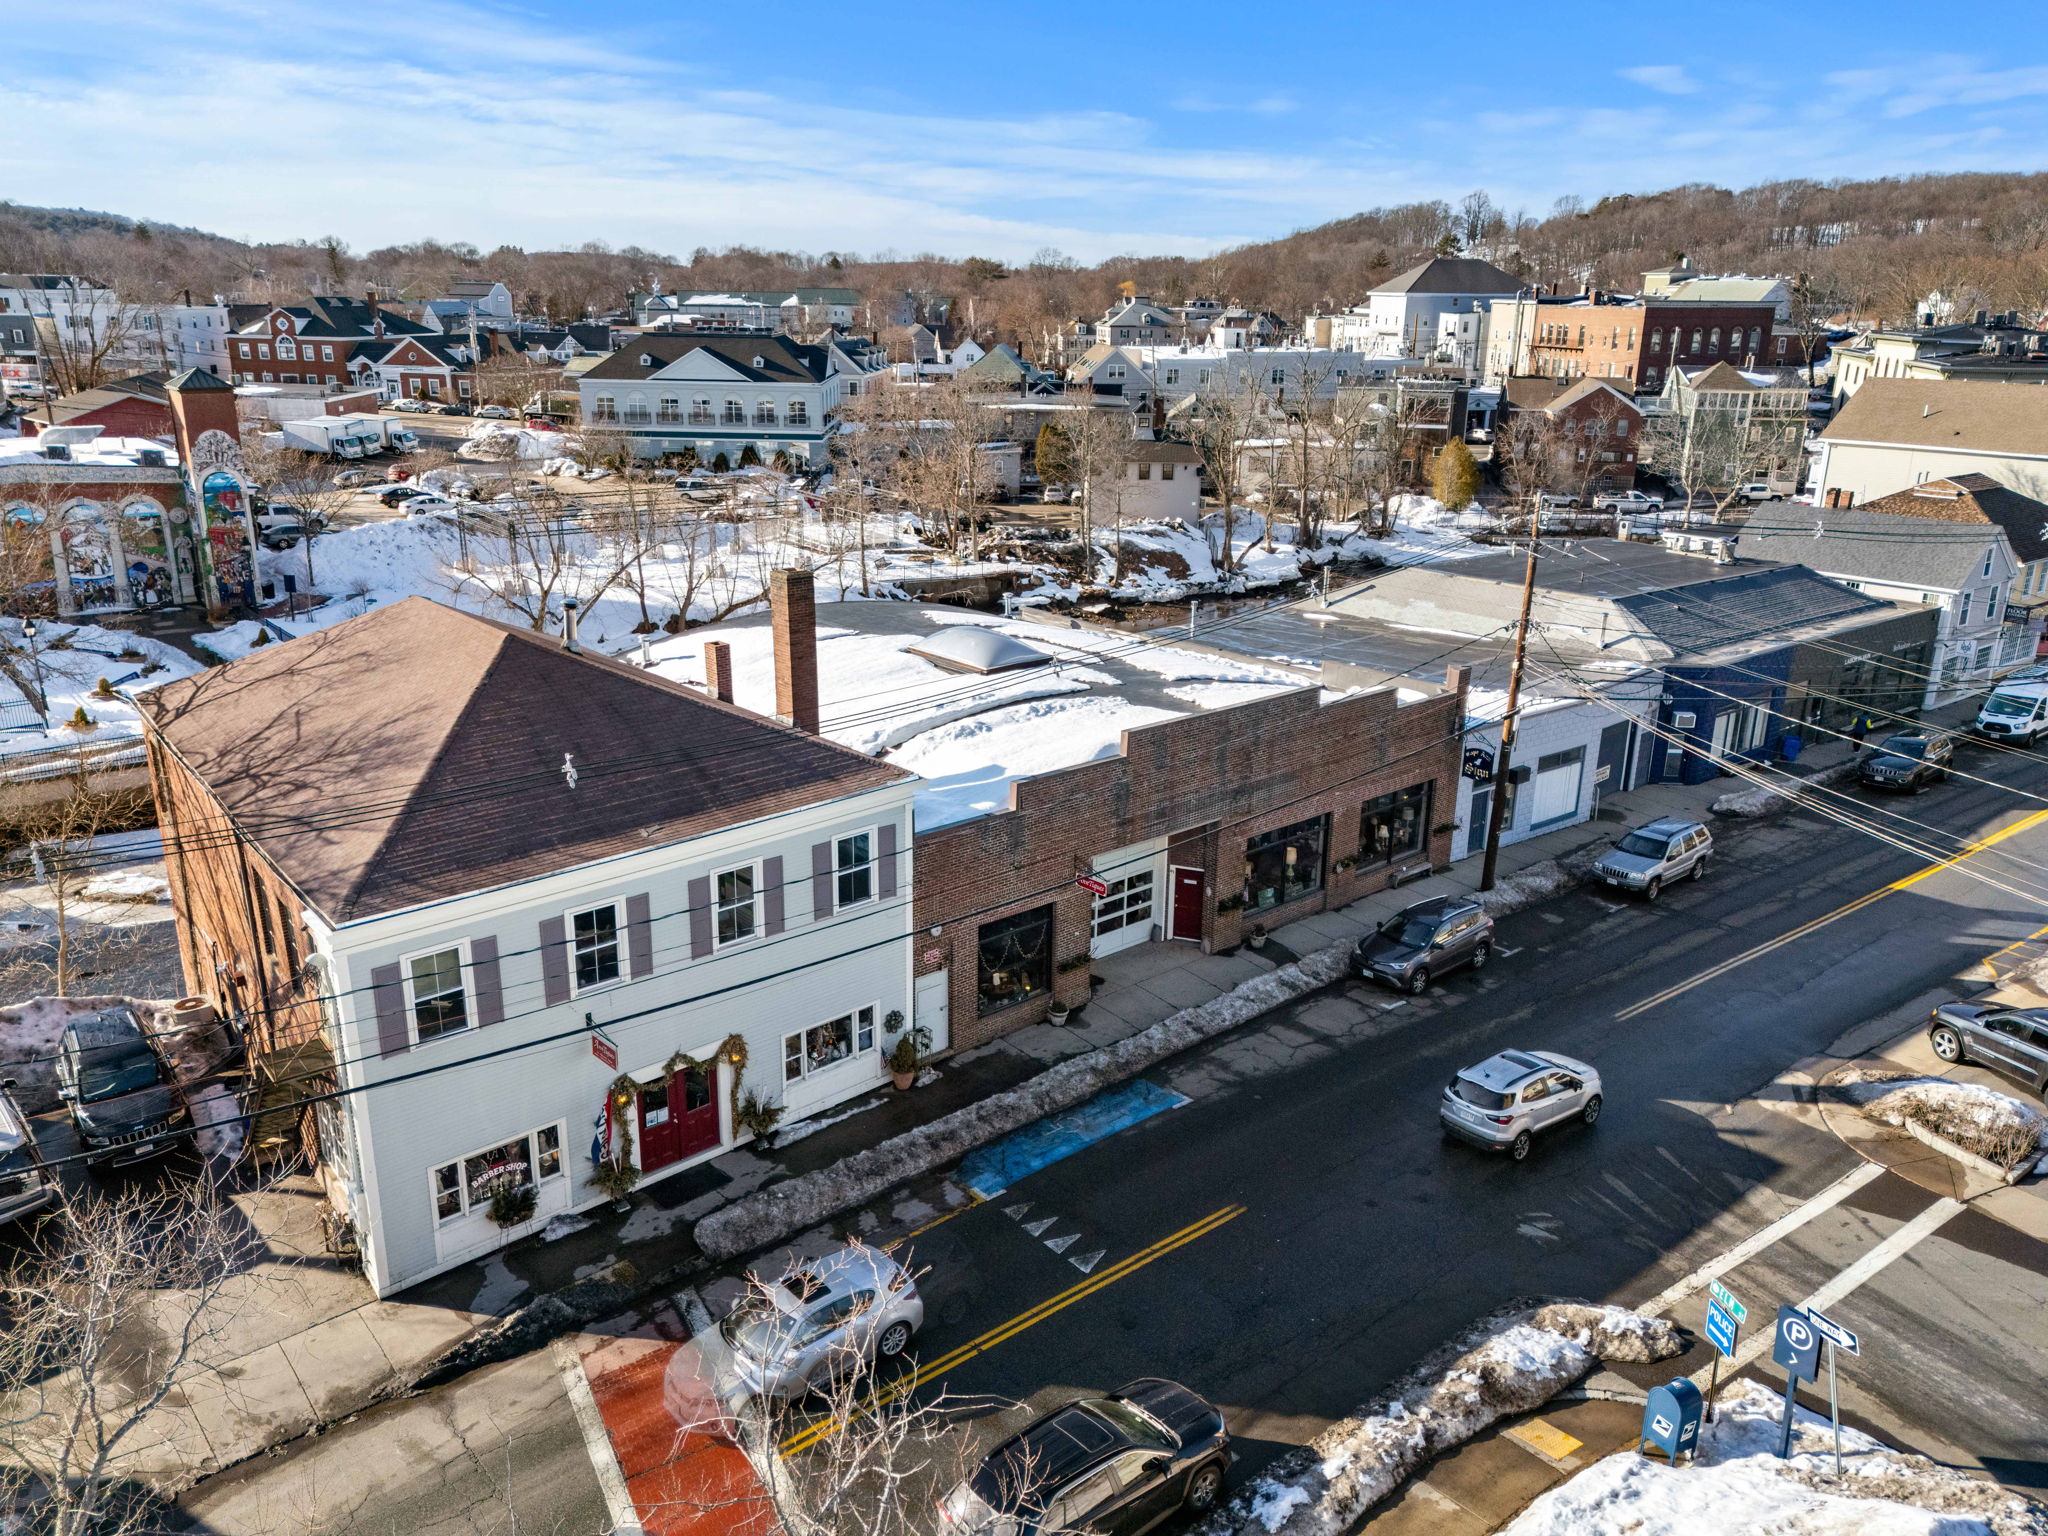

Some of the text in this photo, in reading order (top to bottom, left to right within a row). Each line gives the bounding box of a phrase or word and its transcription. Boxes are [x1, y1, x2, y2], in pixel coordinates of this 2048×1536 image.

[471, 1166, 505, 1188] BARBER
[505, 1162, 528, 1172] SHOP
[1720, 1289, 1736, 1311] ELM
[1709, 1306, 1734, 1338] POLICE
[1790, 1323, 1807, 1342] P
[1811, 1314, 1842, 1339] ONE WAY
